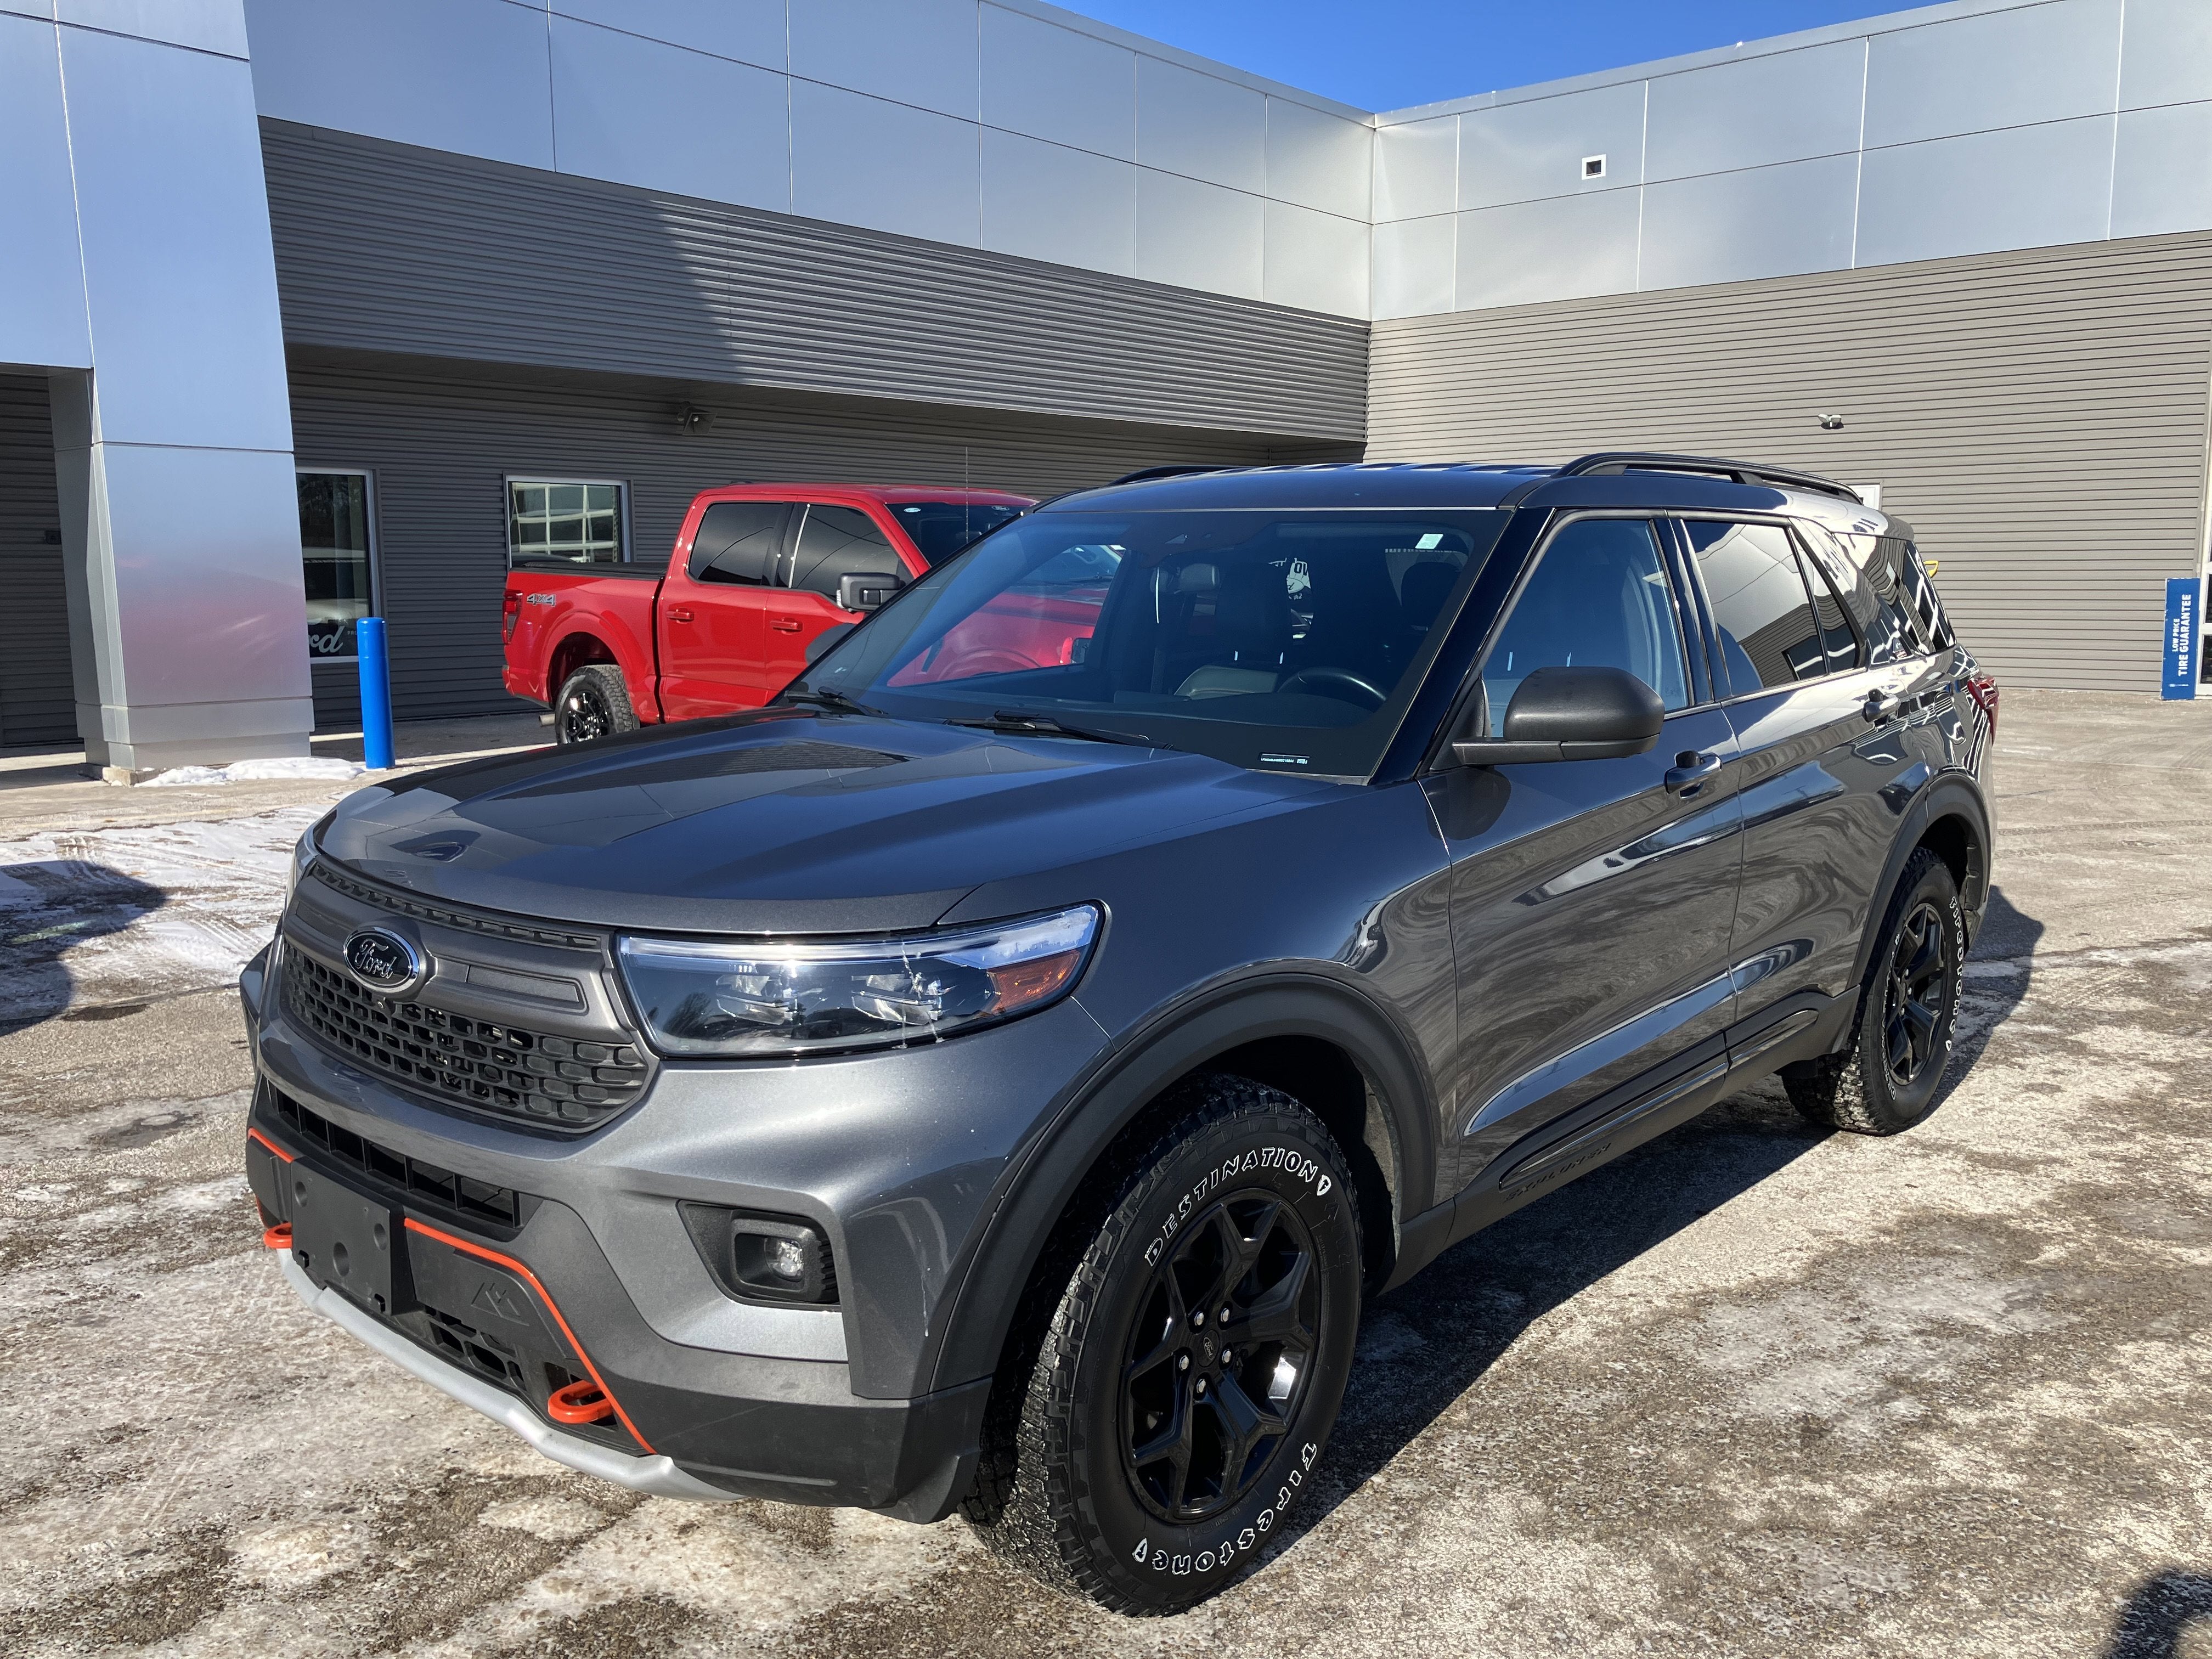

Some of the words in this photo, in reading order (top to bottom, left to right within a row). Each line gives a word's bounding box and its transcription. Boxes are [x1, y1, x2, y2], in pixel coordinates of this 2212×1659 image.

[2180, 594, 2192, 653] GUARANTEE
[2178, 654, 2188, 676] TIRE
[354, 938, 397, 979] Ford
[1144, 1147, 1318, 1267] DESTINATION
